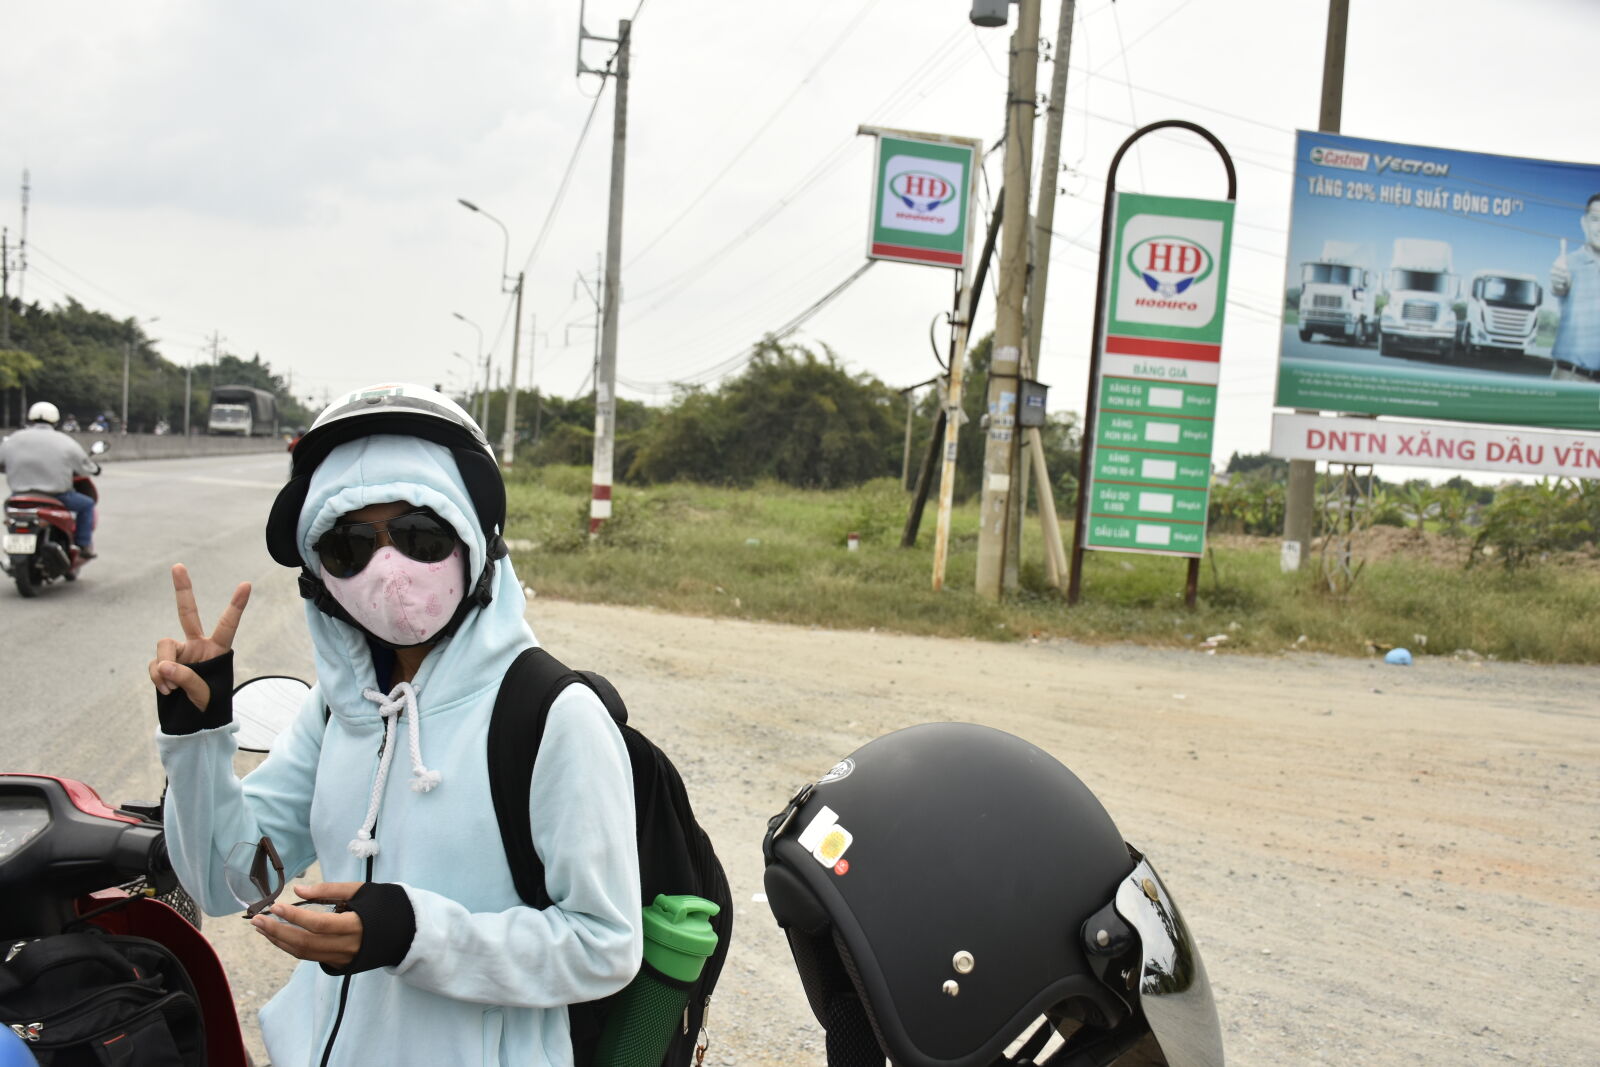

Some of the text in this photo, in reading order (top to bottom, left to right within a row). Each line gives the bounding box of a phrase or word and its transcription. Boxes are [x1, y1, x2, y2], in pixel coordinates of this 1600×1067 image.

[1323, 151, 1366, 169] Castrol
[1308, 175, 1343, 198] TĂNG
[1346, 182, 1377, 201] 20%
[1380, 183, 1411, 208] HIỆU
[1415, 187, 1449, 209] SUẤT
[1452, 193, 1489, 215] ĐỘNG
[1133, 362, 1188, 378] BẢNG GIÁ
[1306, 429, 1387, 454] DNTN
[1397, 430, 1476, 460] XĂNG
[1486, 437, 1544, 465] DẦU
